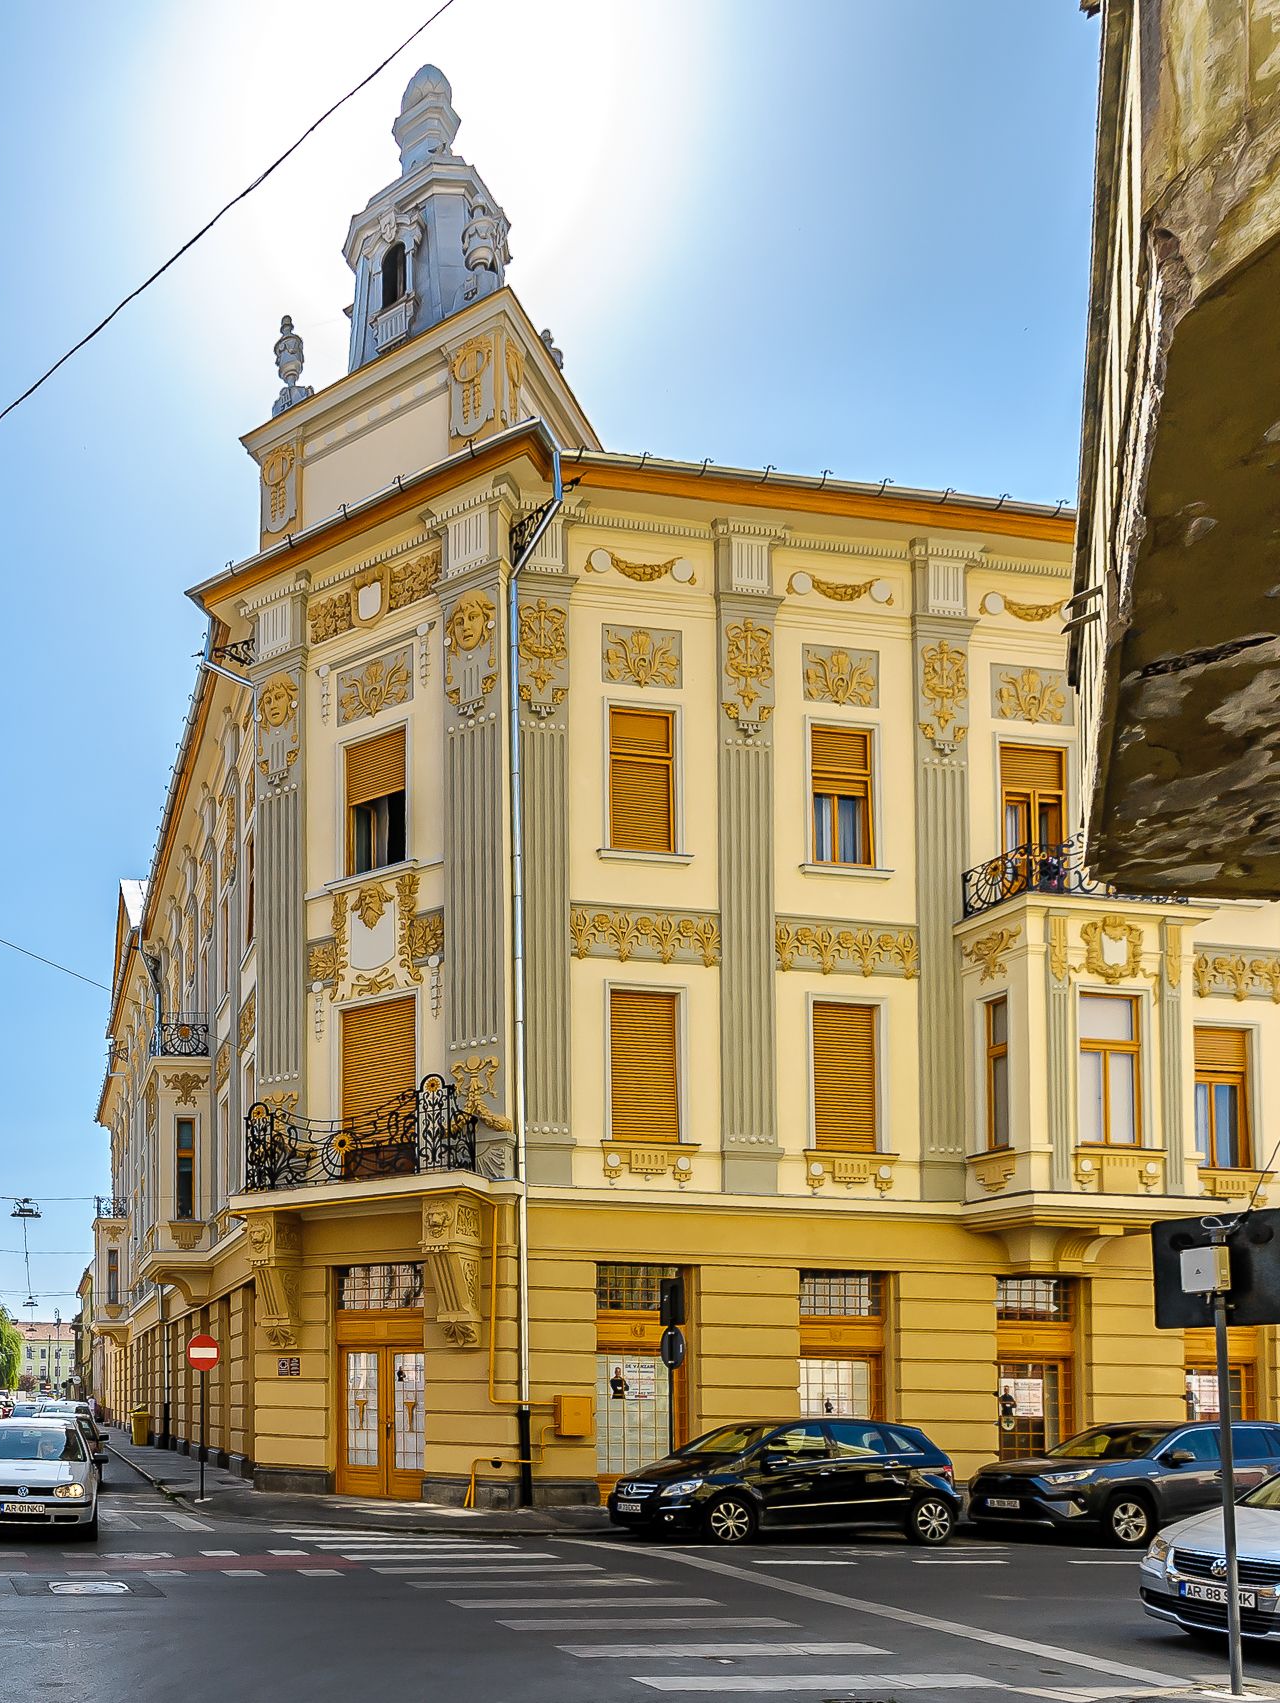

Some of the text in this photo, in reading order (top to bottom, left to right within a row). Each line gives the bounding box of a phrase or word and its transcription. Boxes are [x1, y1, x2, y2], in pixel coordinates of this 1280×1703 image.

[5, 1504, 17, 1512] AR
[1187, 1585, 1202, 1597] AR
[1206, 1588, 1221, 1600] 88
